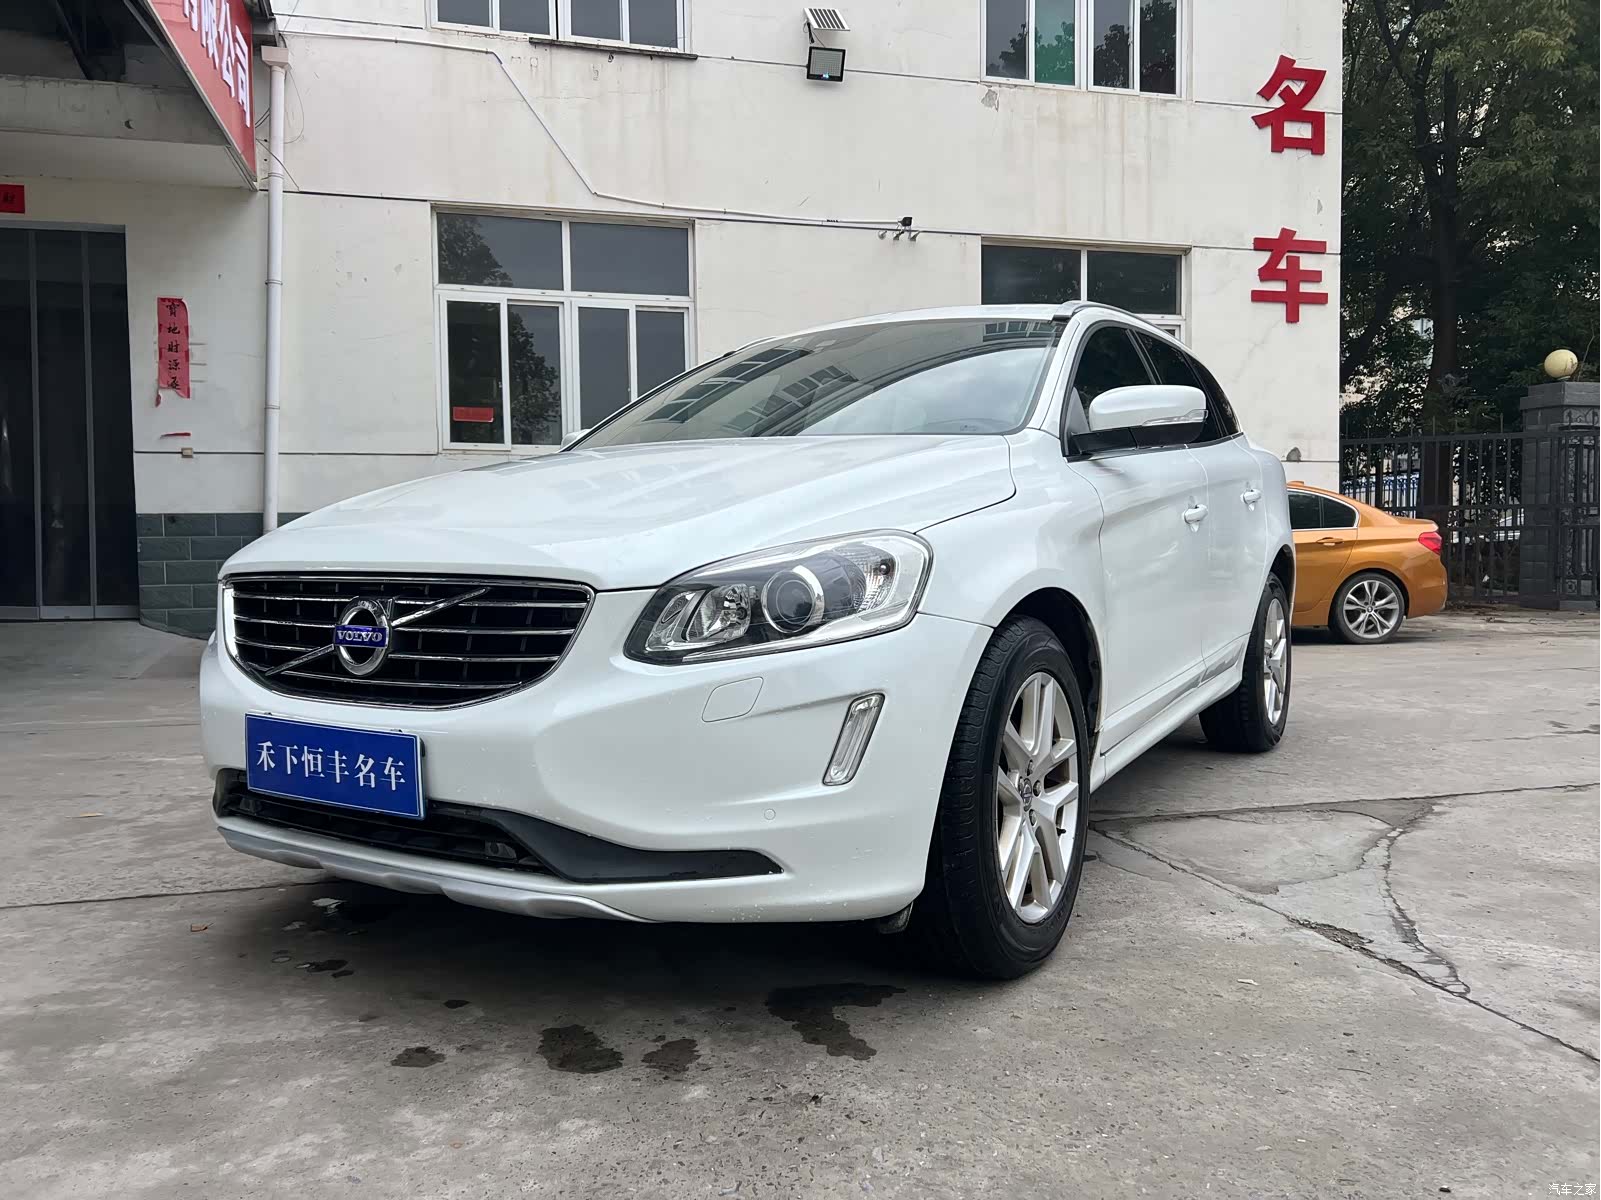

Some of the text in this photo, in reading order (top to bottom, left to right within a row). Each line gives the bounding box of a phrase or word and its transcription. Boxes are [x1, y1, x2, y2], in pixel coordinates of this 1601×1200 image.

[1251, 54, 1328, 323] 名车
[337, 630, 383, 642] VOLVO
[256, 741, 405, 791] 禾下恒丰名车
